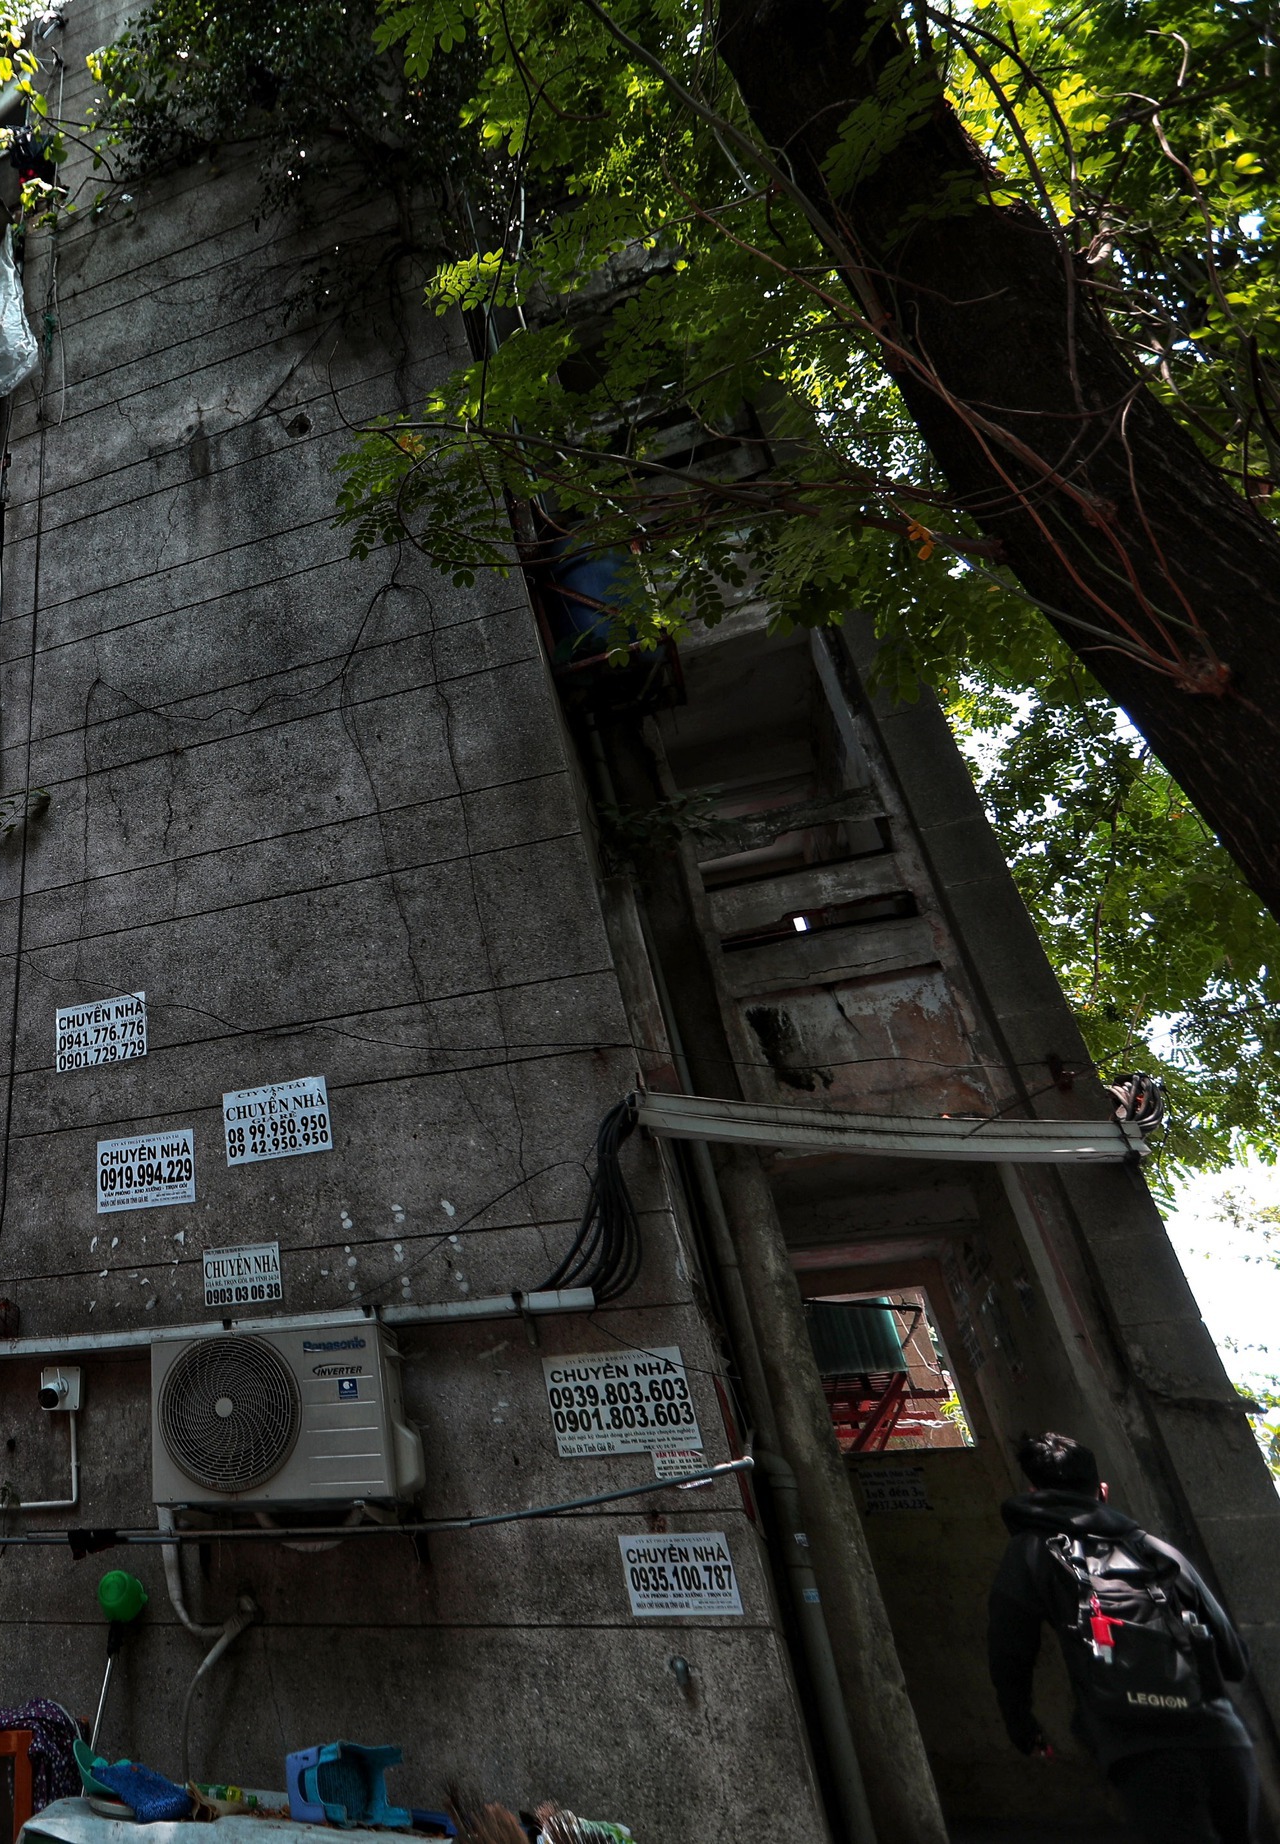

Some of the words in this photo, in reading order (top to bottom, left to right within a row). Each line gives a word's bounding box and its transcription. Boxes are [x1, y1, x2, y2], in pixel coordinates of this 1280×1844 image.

[58, 1004, 110, 1030] CHUYỂN
[59, 1019, 144, 1052] 0941.776.776
[59, 1039, 144, 1070] 0901.729.729
[237, 1090, 258, 1098] CTY
[261, 1085, 284, 1093] VẬN
[286, 1081, 305, 1089] TẢI
[225, 1091, 288, 1121] CHUYỂN
[292, 1088, 325, 1110] NHÀ
[227, 1127, 244, 1144] 08
[248, 1113, 326, 1140] 99.950.950
[100, 1143, 156, 1166] CHUYỂN
[160, 1137, 190, 1158] NHÀ
[228, 1143, 245, 1158] 09
[250, 1129, 328, 1154] 42.950.950
[100, 1157, 192, 1191] 0919.994.229
[204, 1252, 251, 1279] CHUYỂN
[253, 1248, 278, 1273] NHÀ
[206, 1287, 233, 1304] 0903
[235, 1286, 248, 1301] 03
[250, 1284, 264, 1300] 06
[266, 1282, 280, 1298] 38
[303, 1336, 366, 1351] Panasonic
[550, 1362, 629, 1383] CHUYỂN
[549, 1377, 688, 1409] 0939.803.603
[553, 1401, 694, 1433] 0901.803.603
[626, 1543, 689, 1564] CHUYỂN
[692, 1542, 728, 1562] NHÀ
[630, 1564, 732, 1591] 0935.100.787
[1126, 1690, 1188, 1709] LEGION
